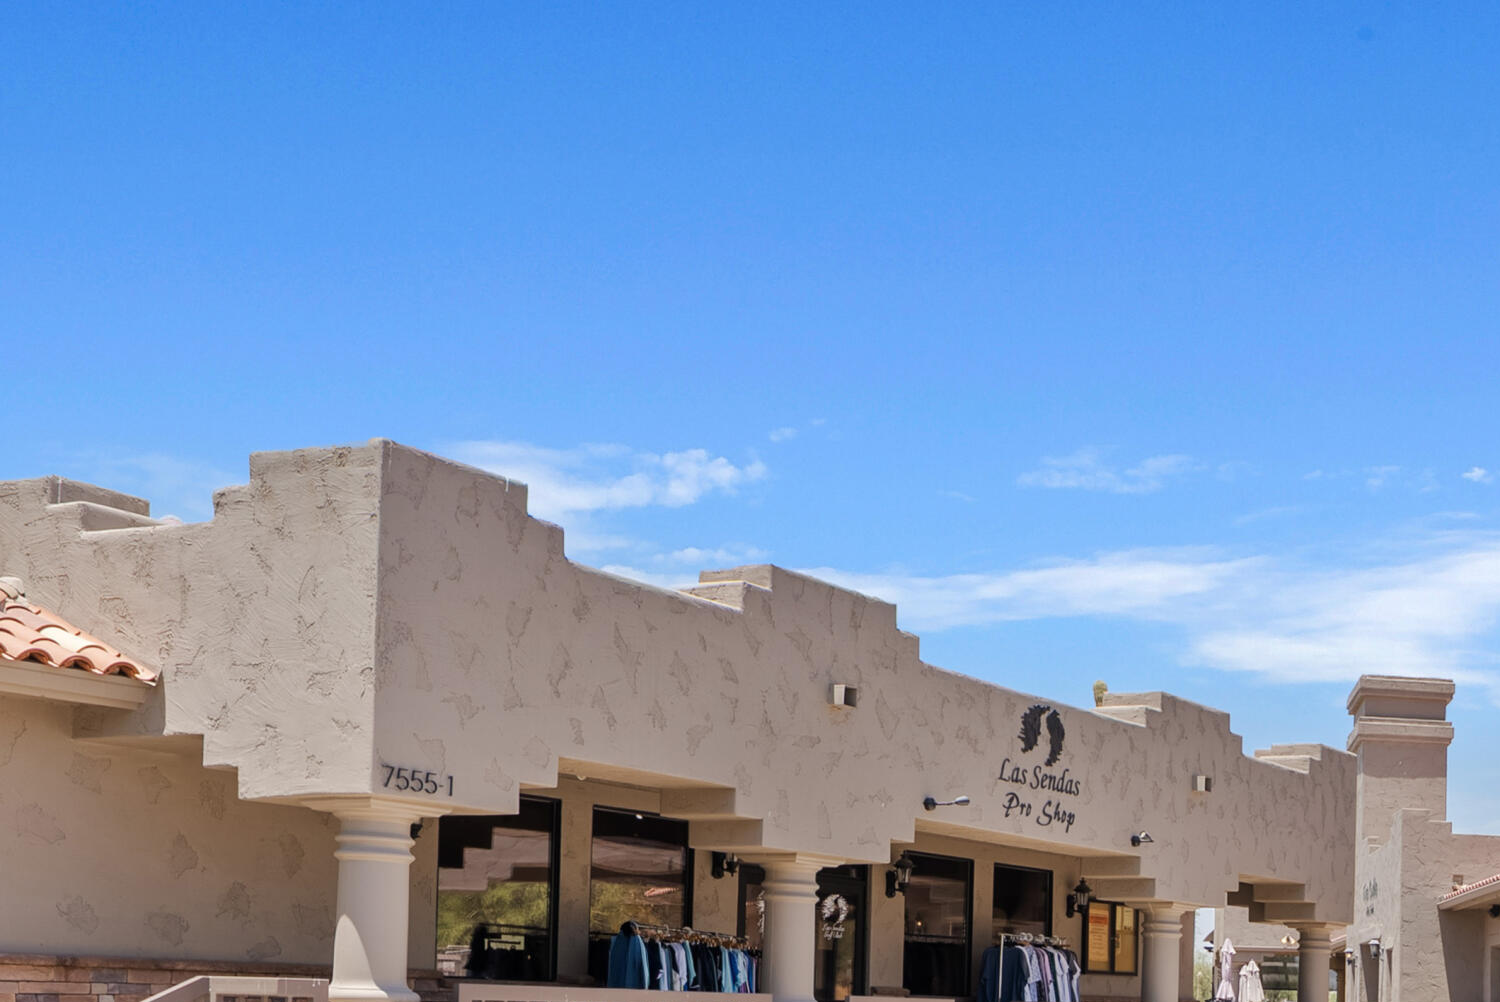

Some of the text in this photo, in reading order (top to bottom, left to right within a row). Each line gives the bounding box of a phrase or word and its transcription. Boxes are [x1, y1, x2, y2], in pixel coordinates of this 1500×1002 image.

[381, 763, 454, 797] 7555-1
[998, 758, 1081, 796] Las Sendas
[1002, 792, 1075, 833] Pro Shop
